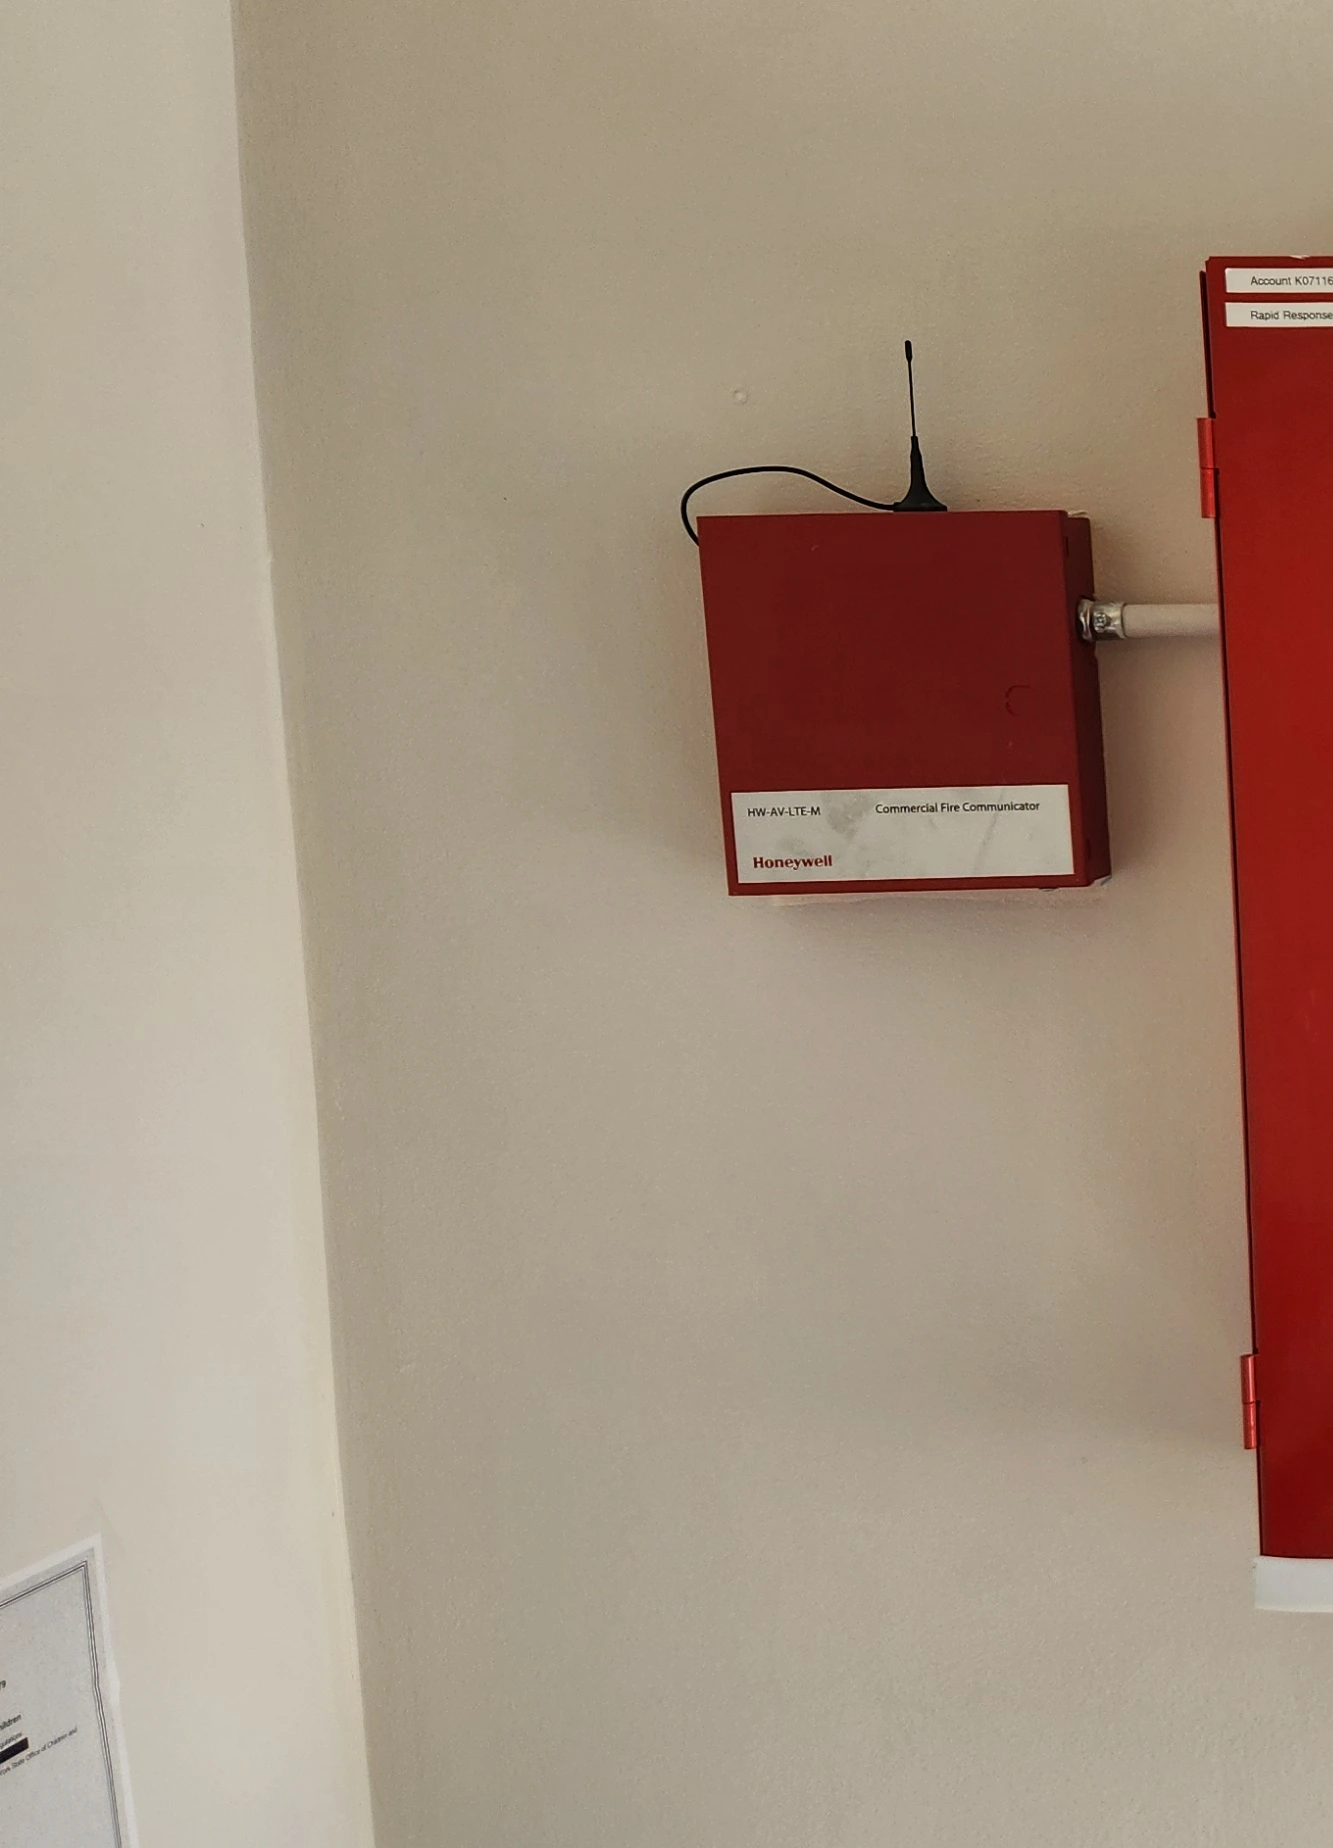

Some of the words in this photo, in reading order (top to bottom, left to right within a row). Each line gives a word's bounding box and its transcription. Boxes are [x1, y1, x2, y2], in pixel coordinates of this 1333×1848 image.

[1250, 276, 1292, 287] Account
[1250, 311, 1280, 321] Rapid
[1284, 310, 1333, 321] Response
[747, 806, 821, 817] HW-AV-LTE-M
[875, 803, 938, 814] Commercial
[941, 802, 961, 812] Fire
[962, 801, 1040, 812] Communicator
[753, 855, 833, 870] Honeywell
